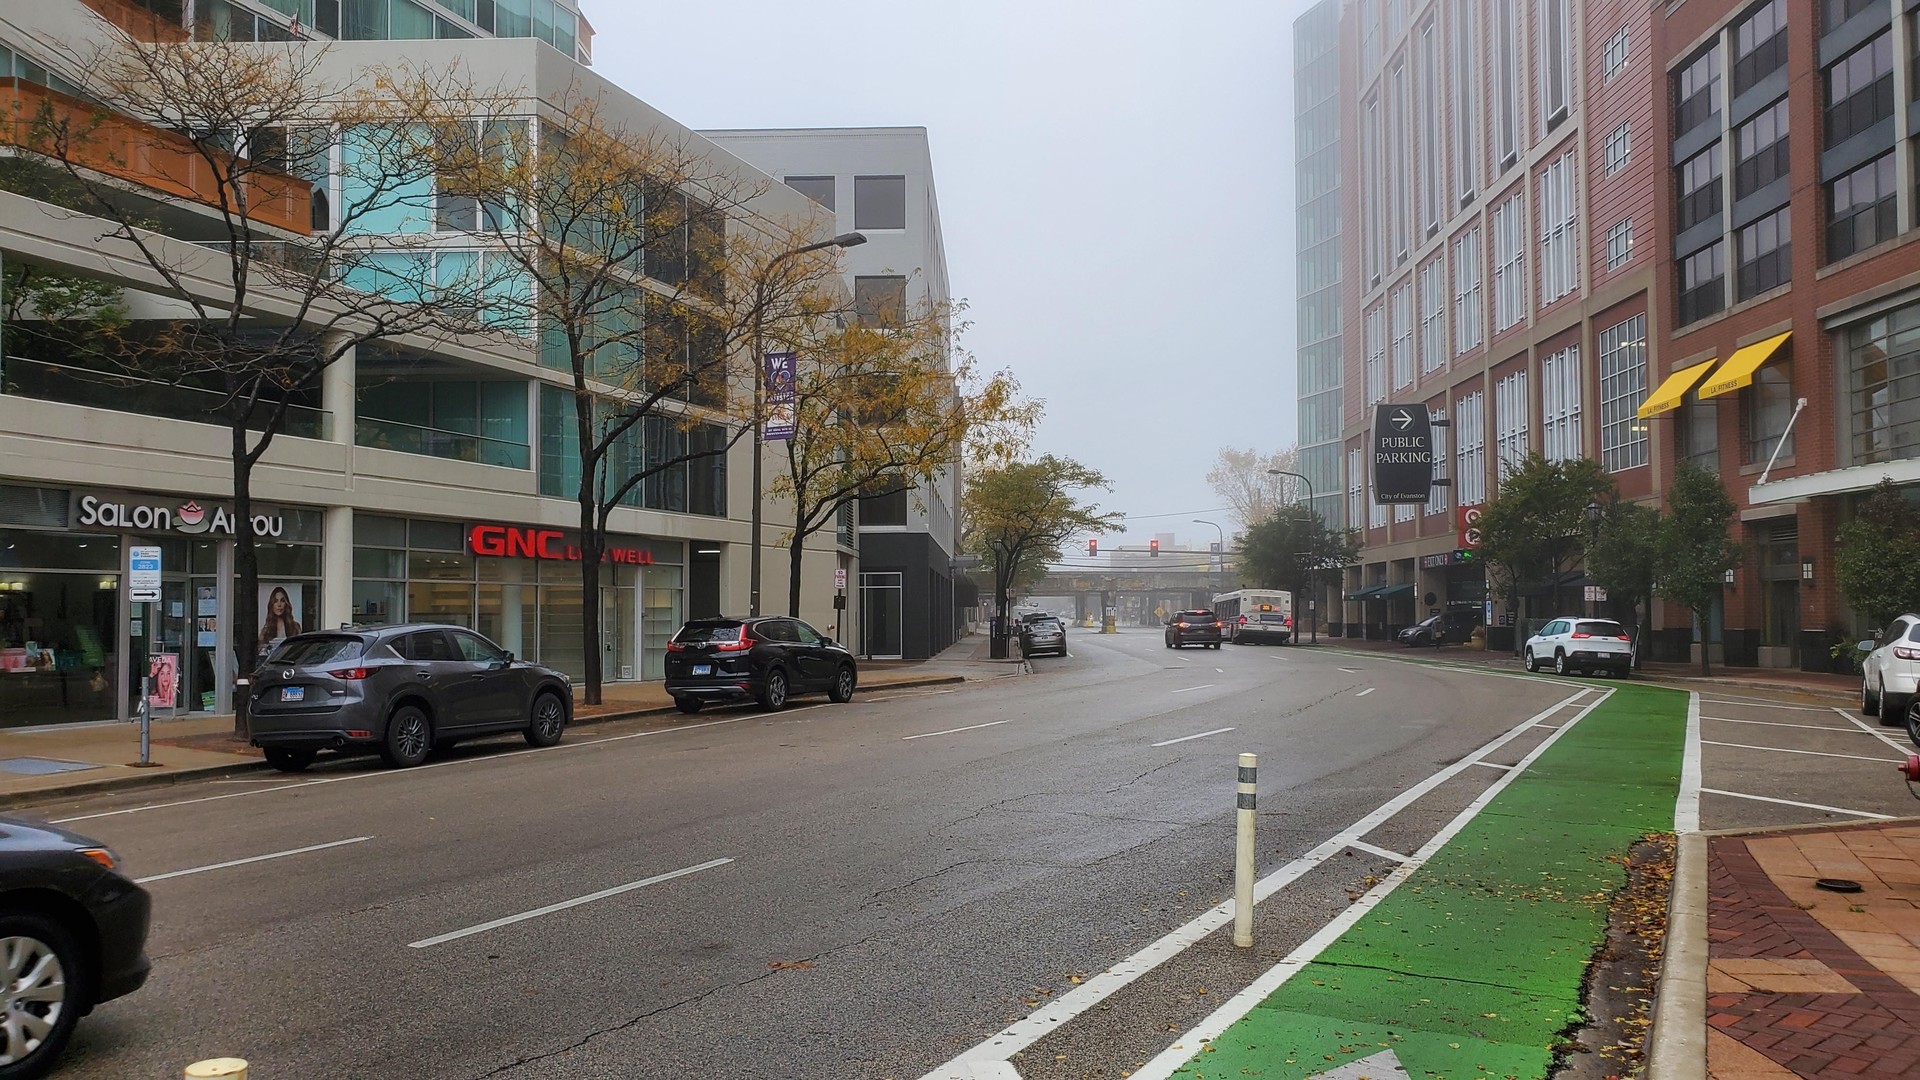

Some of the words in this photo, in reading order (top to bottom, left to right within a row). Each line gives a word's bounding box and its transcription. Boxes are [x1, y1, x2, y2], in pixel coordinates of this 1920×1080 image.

[1718, 380, 1738, 391] FITNESS
[1653, 402, 1670, 413] FITNESS
[1381, 436, 1425, 448] PUBLIC
[1376, 451, 1431, 464] PARKING
[472, 525, 564, 560] GNC
[610, 548, 655, 564] WELL
